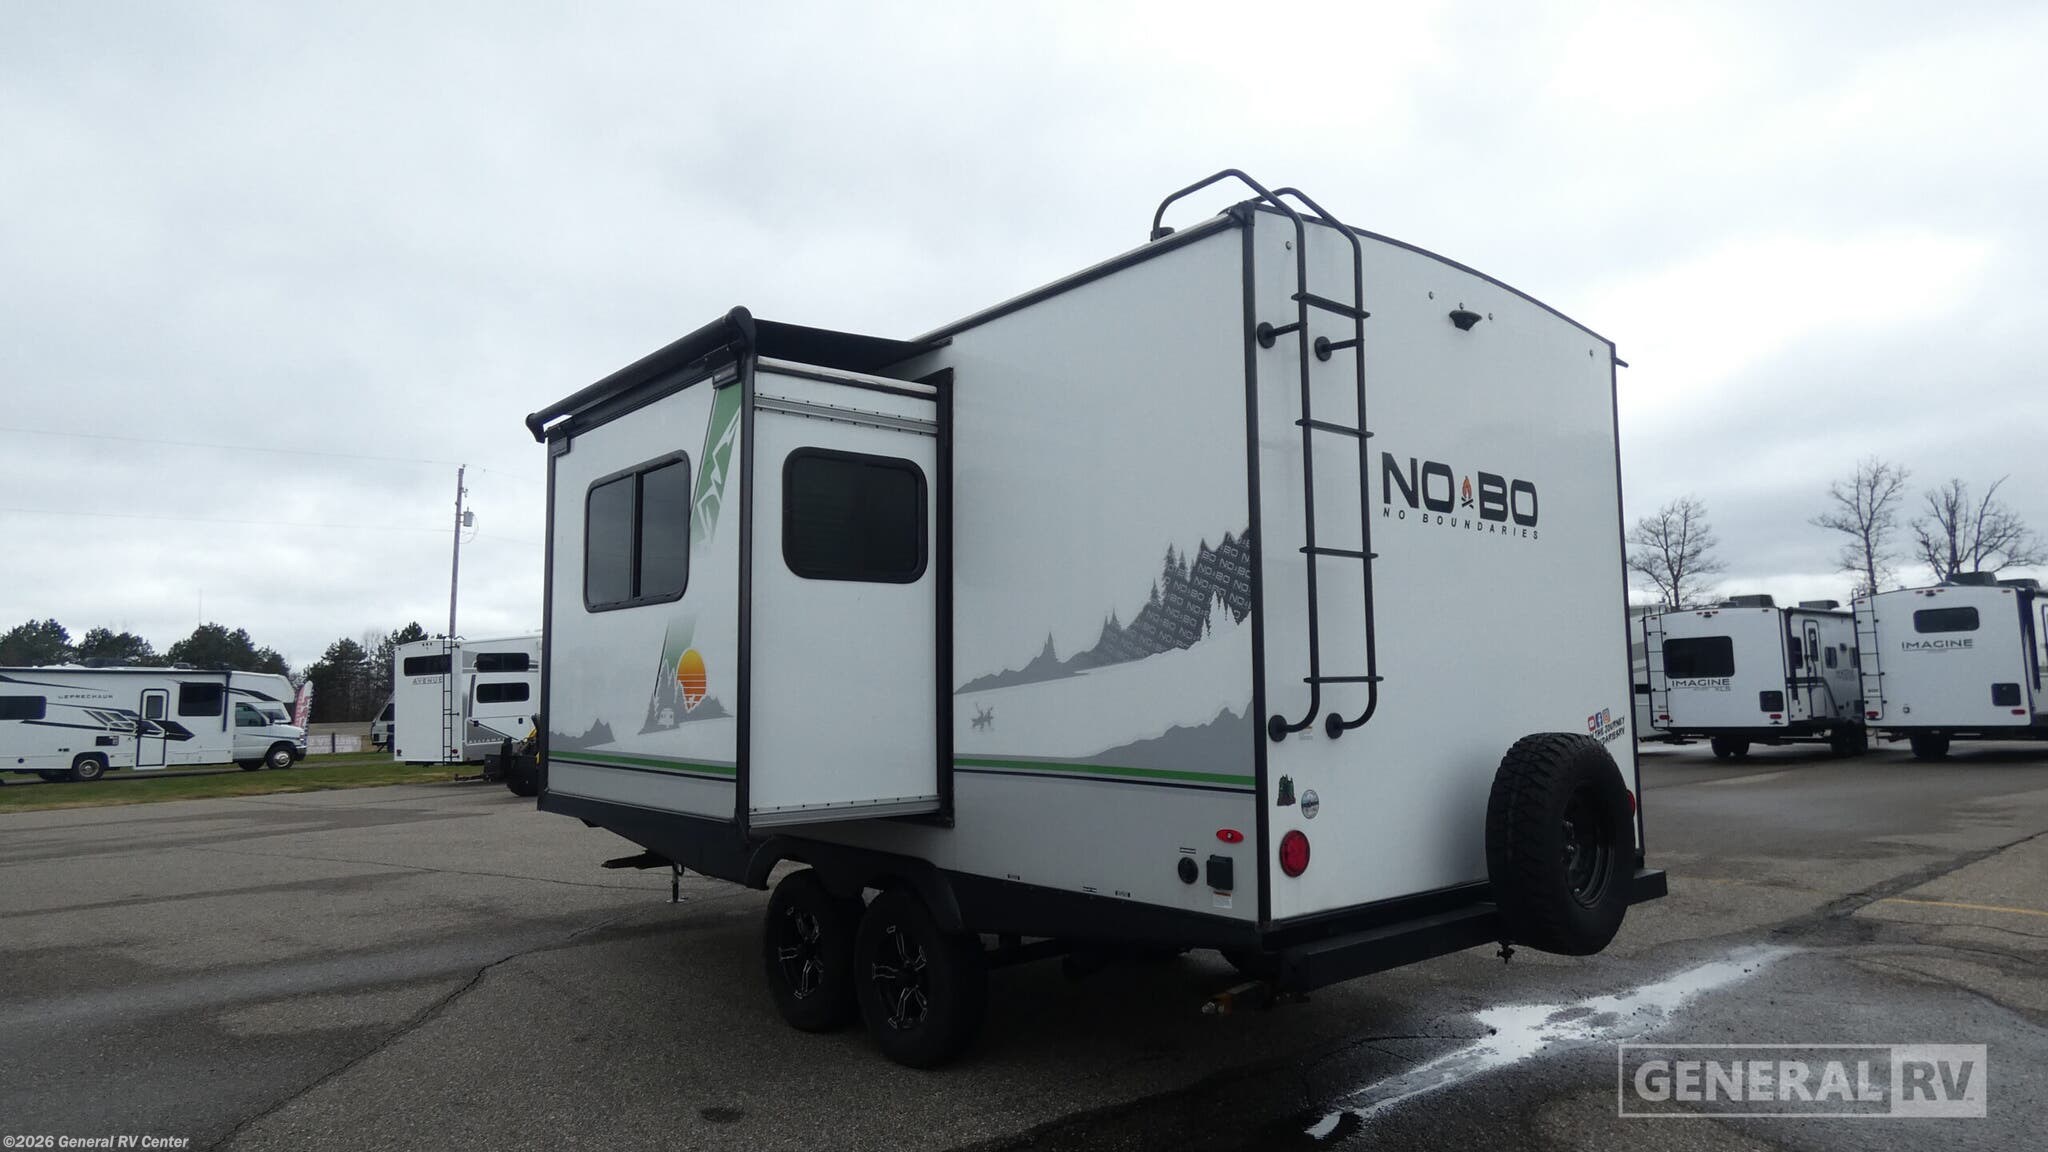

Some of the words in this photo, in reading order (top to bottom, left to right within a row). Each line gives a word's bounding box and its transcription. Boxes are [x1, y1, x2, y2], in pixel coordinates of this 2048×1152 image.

[1382, 452, 1455, 514] NO
[1478, 471, 1539, 528] BO
[1383, 507, 1406, 520] NO
[1423, 513, 1538, 540] BOUNDARIES
[1901, 638, 1973, 649] IMAGINE
[1671, 678, 1730, 688] IMAGINE
